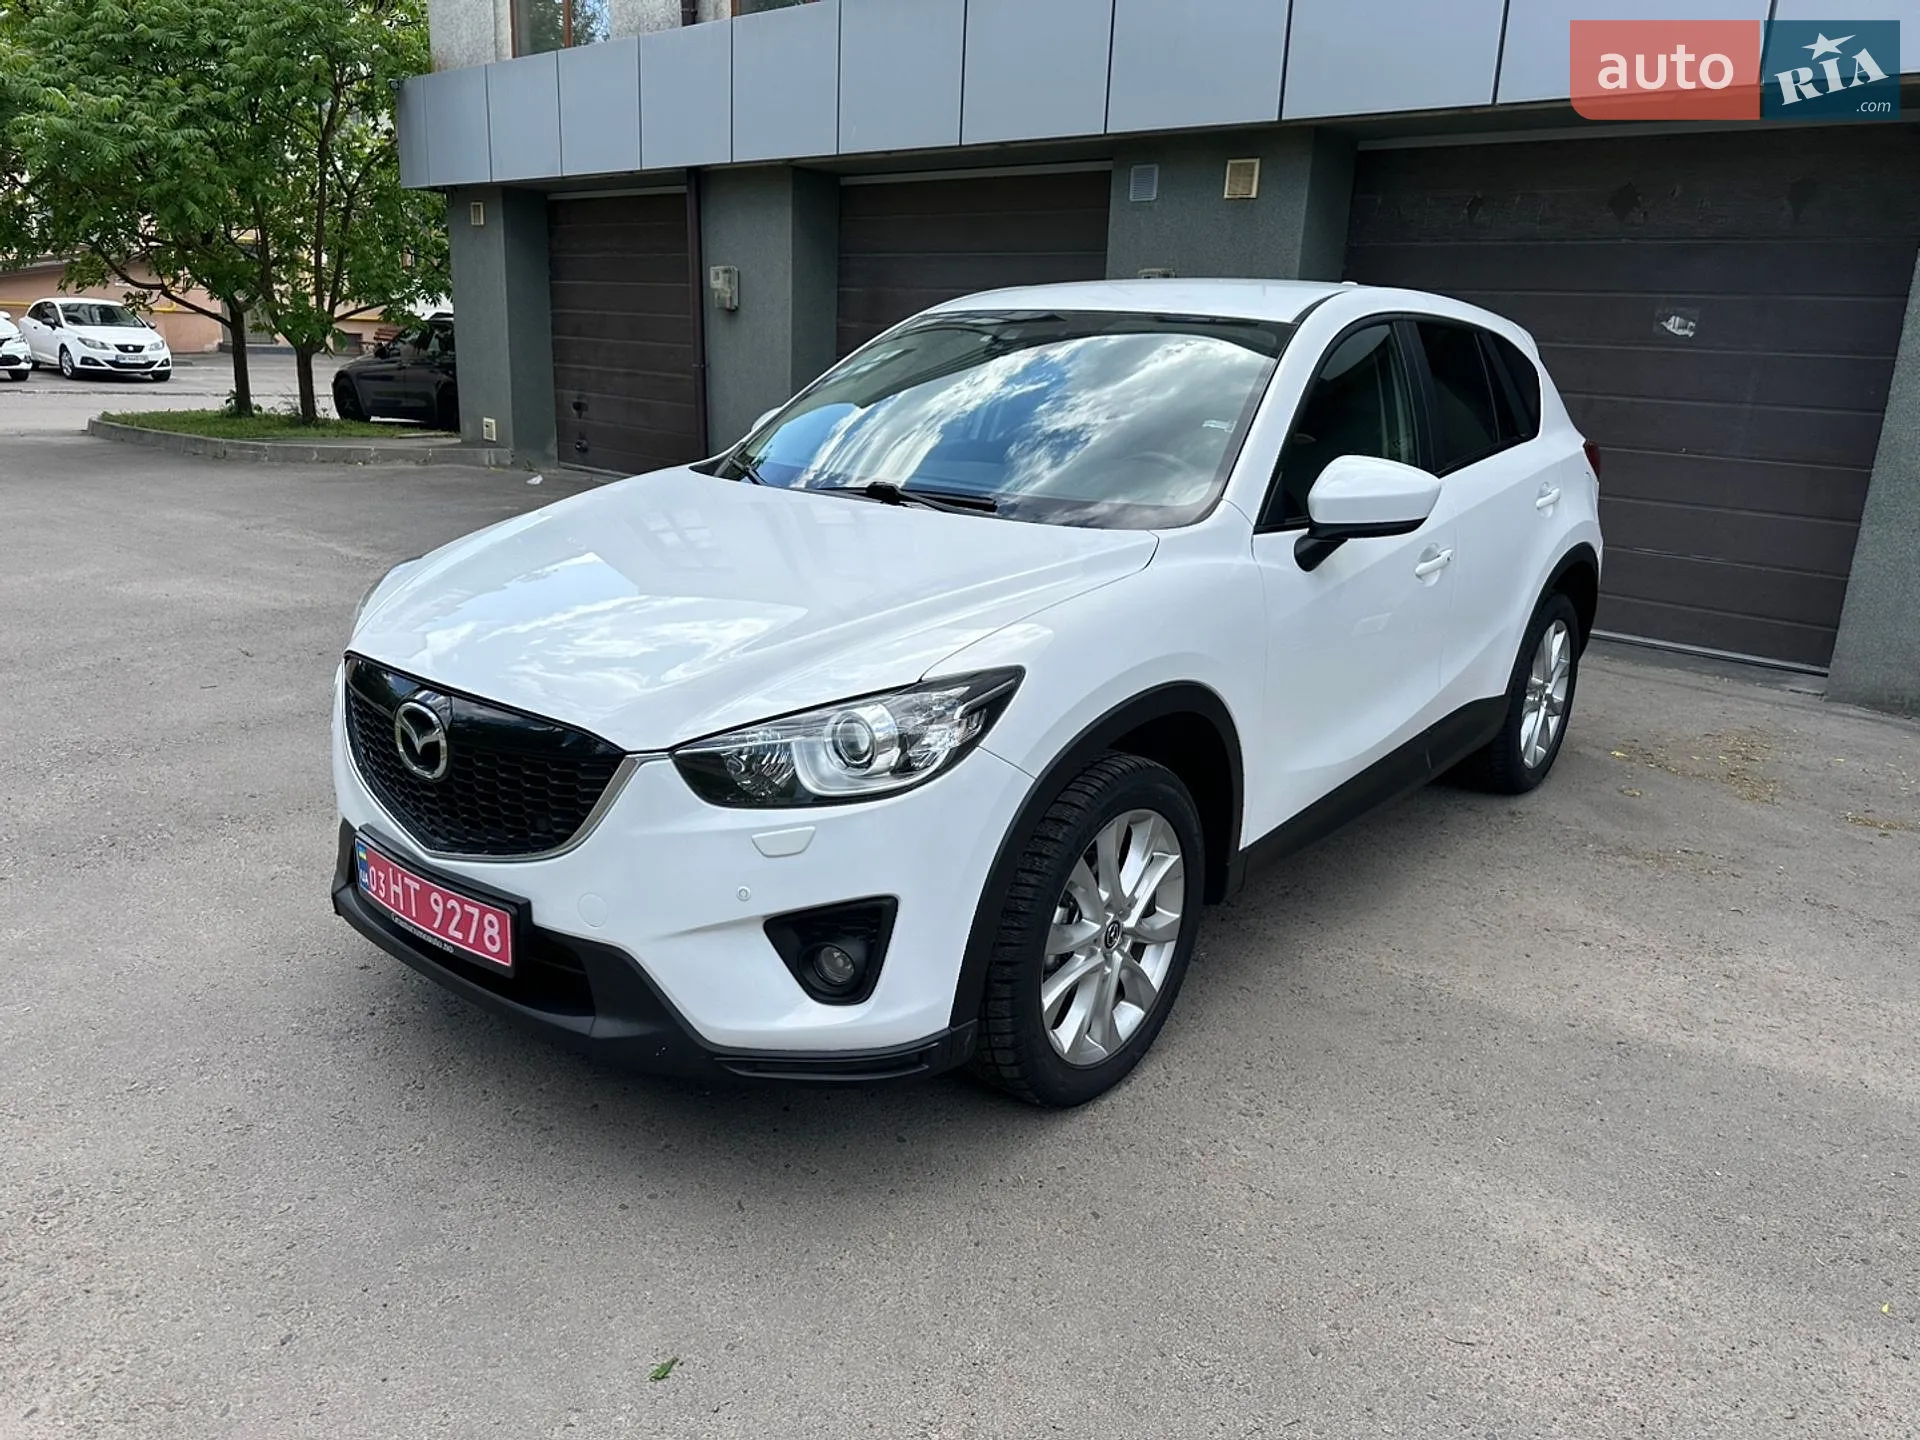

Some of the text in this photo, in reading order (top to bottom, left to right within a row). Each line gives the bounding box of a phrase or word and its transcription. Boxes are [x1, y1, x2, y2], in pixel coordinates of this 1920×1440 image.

[369, 866, 386, 898] 03
[389, 867, 420, 918] HT
[429, 891, 502, 954] 9278
